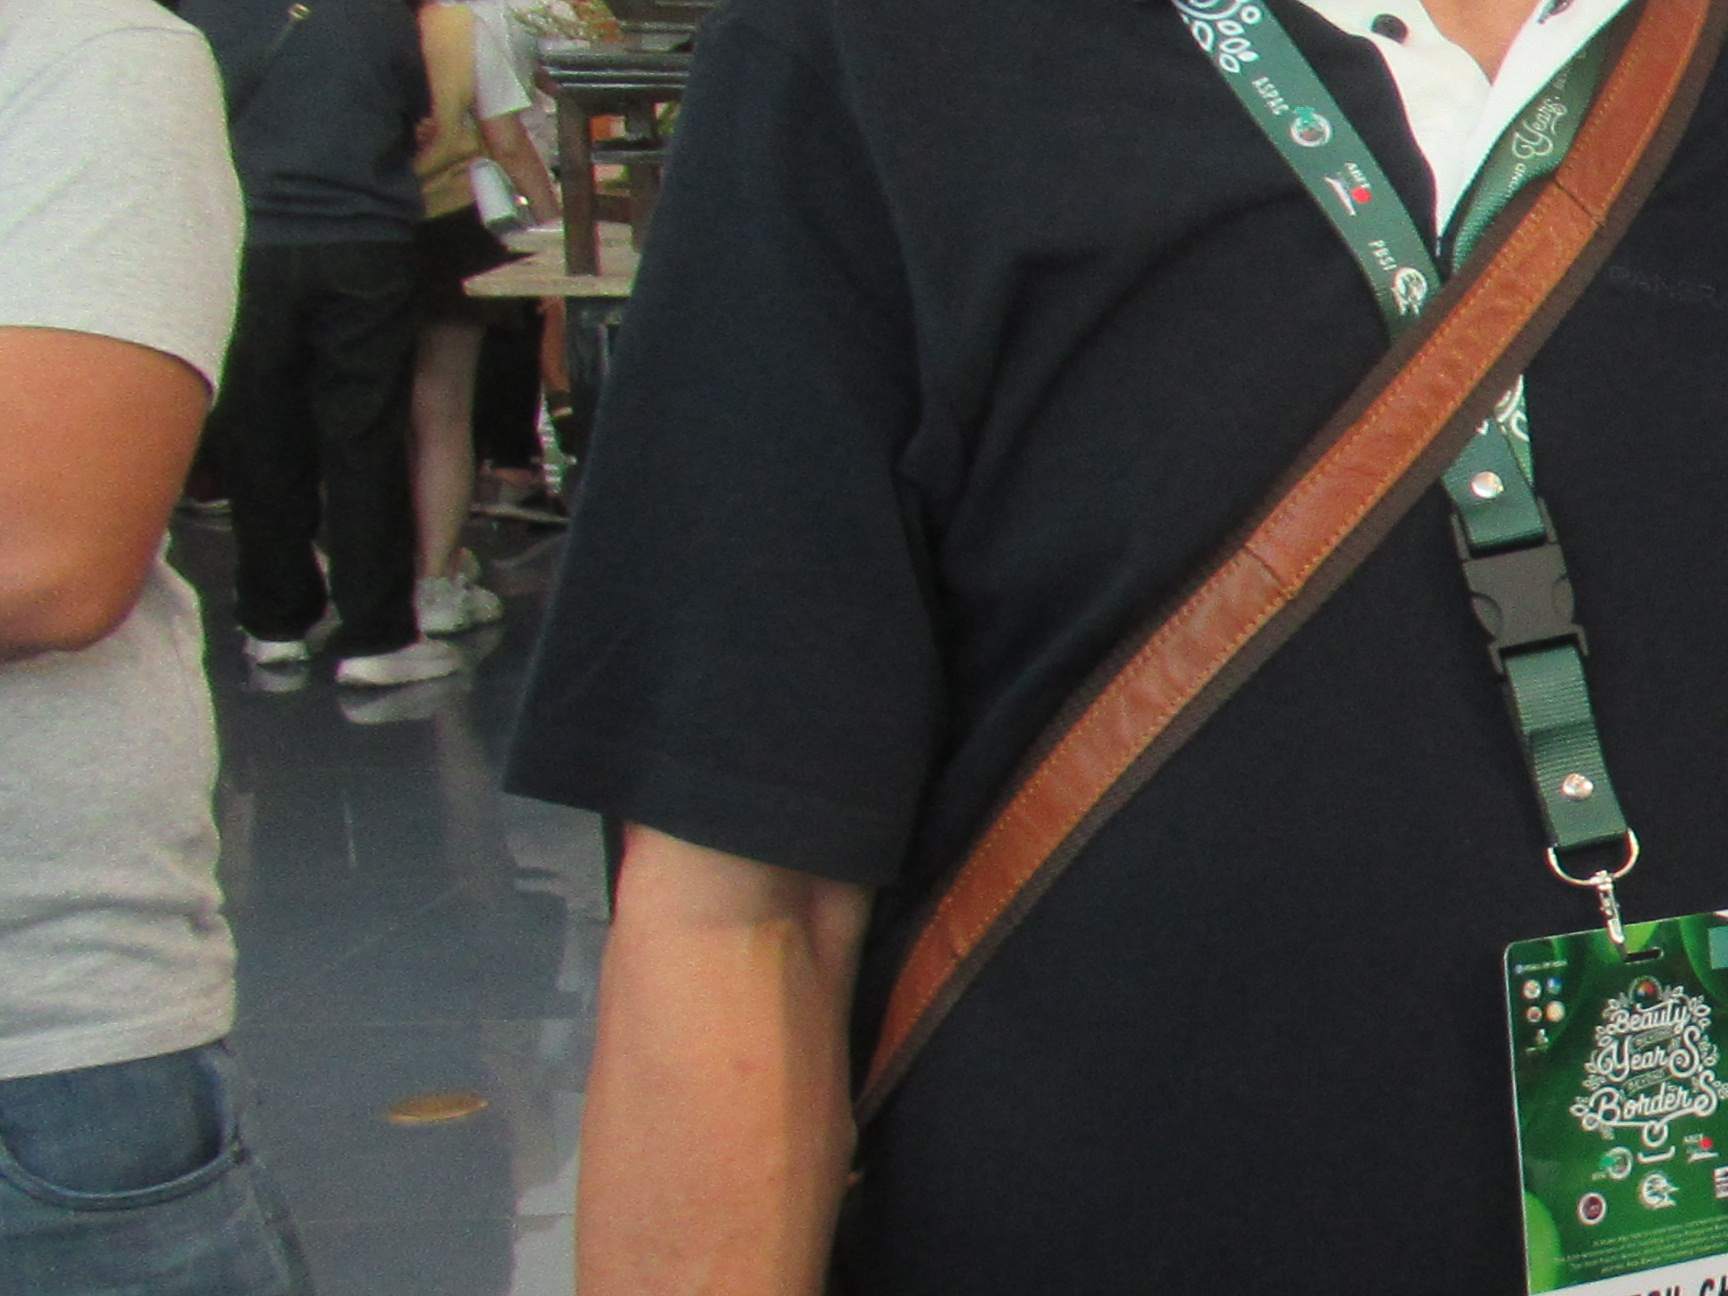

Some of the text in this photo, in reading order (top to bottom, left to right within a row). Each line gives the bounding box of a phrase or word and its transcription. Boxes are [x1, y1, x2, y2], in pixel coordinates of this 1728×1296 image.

[1251, 76, 1290, 117] ASPAC
[1368, 239, 1398, 272] PBSI
[1607, 997, 1691, 1035] Beauty
